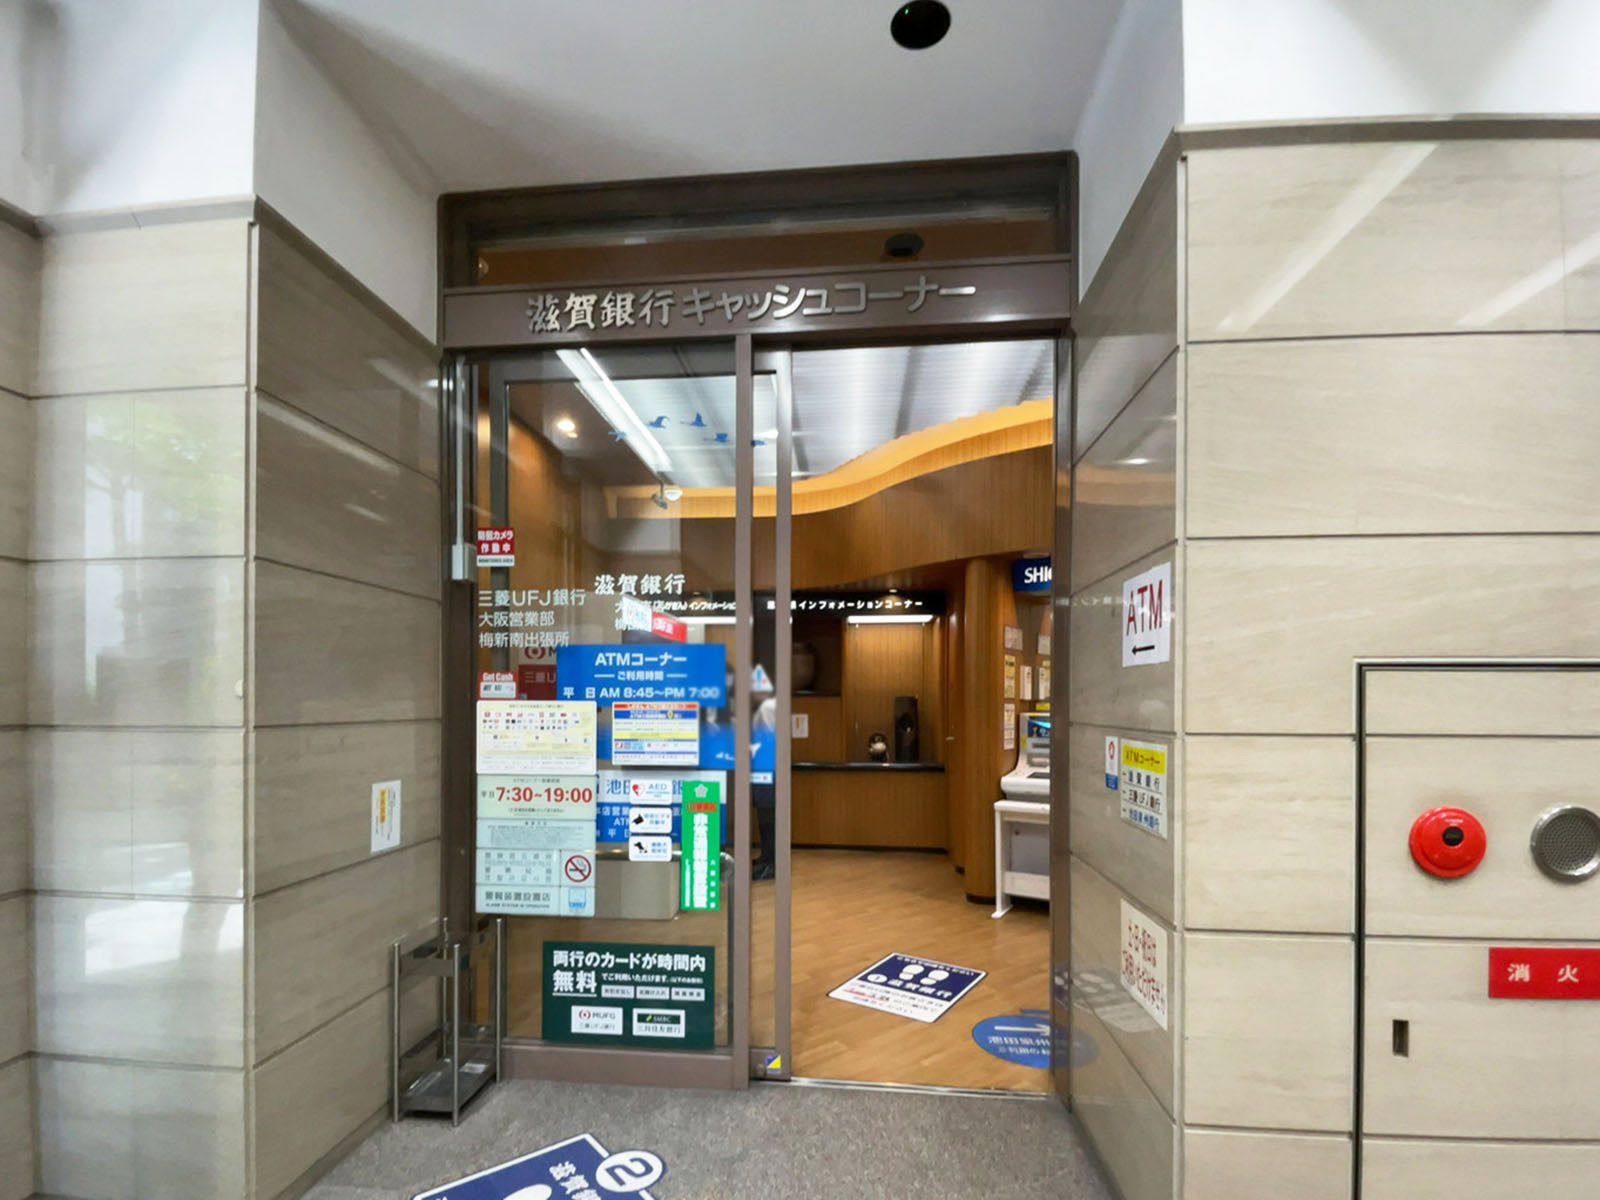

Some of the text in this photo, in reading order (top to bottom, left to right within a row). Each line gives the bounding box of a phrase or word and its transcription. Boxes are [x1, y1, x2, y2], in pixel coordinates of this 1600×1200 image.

[594, 573, 686, 595] 滋賀銀行
[478, 588, 586, 606] 三菱UFJ銀行
[1126, 580, 1163, 636] ATM
[478, 610, 555, 627] 大阪営業部
[478, 631, 570, 647] 梅新南出張所
[594, 653, 687, 666] ATMコーナー
[617, 670, 664, 681] ご利用時間
[600, 687, 620, 698] AM
[689, 687, 720, 698] 7:00
[552, 950, 706, 972] 両行のカードが時間内
[552, 970, 598, 994] 無料
[605, 1157, 654, 1187] 2
